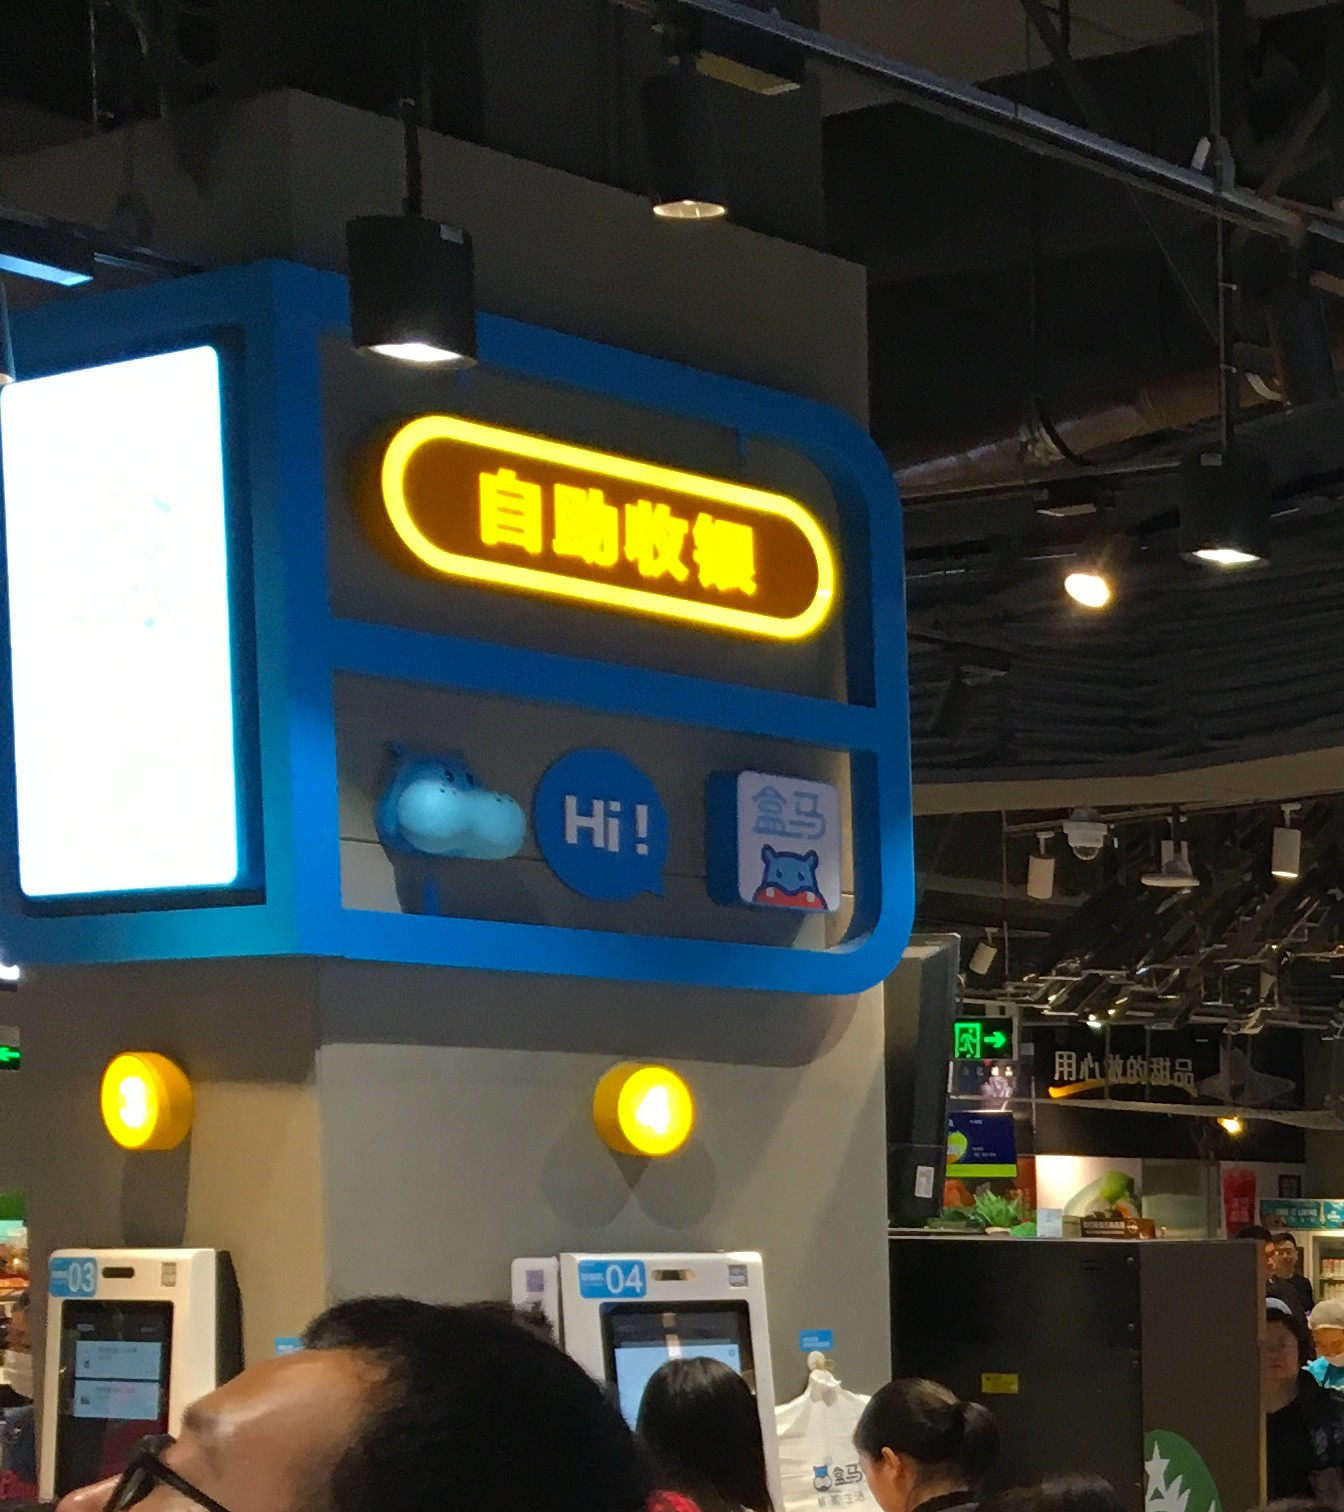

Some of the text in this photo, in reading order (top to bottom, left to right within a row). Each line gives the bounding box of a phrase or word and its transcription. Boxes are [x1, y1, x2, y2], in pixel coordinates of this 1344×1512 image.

[479, 469, 756, 596] 自助收银
[564, 798, 648, 857] Hi!
[752, 785, 827, 840] 盒马
[68, 1261, 96, 1293] 03
[606, 1264, 643, 1294] 04
[833, 1464, 863, 1486] 盒马
